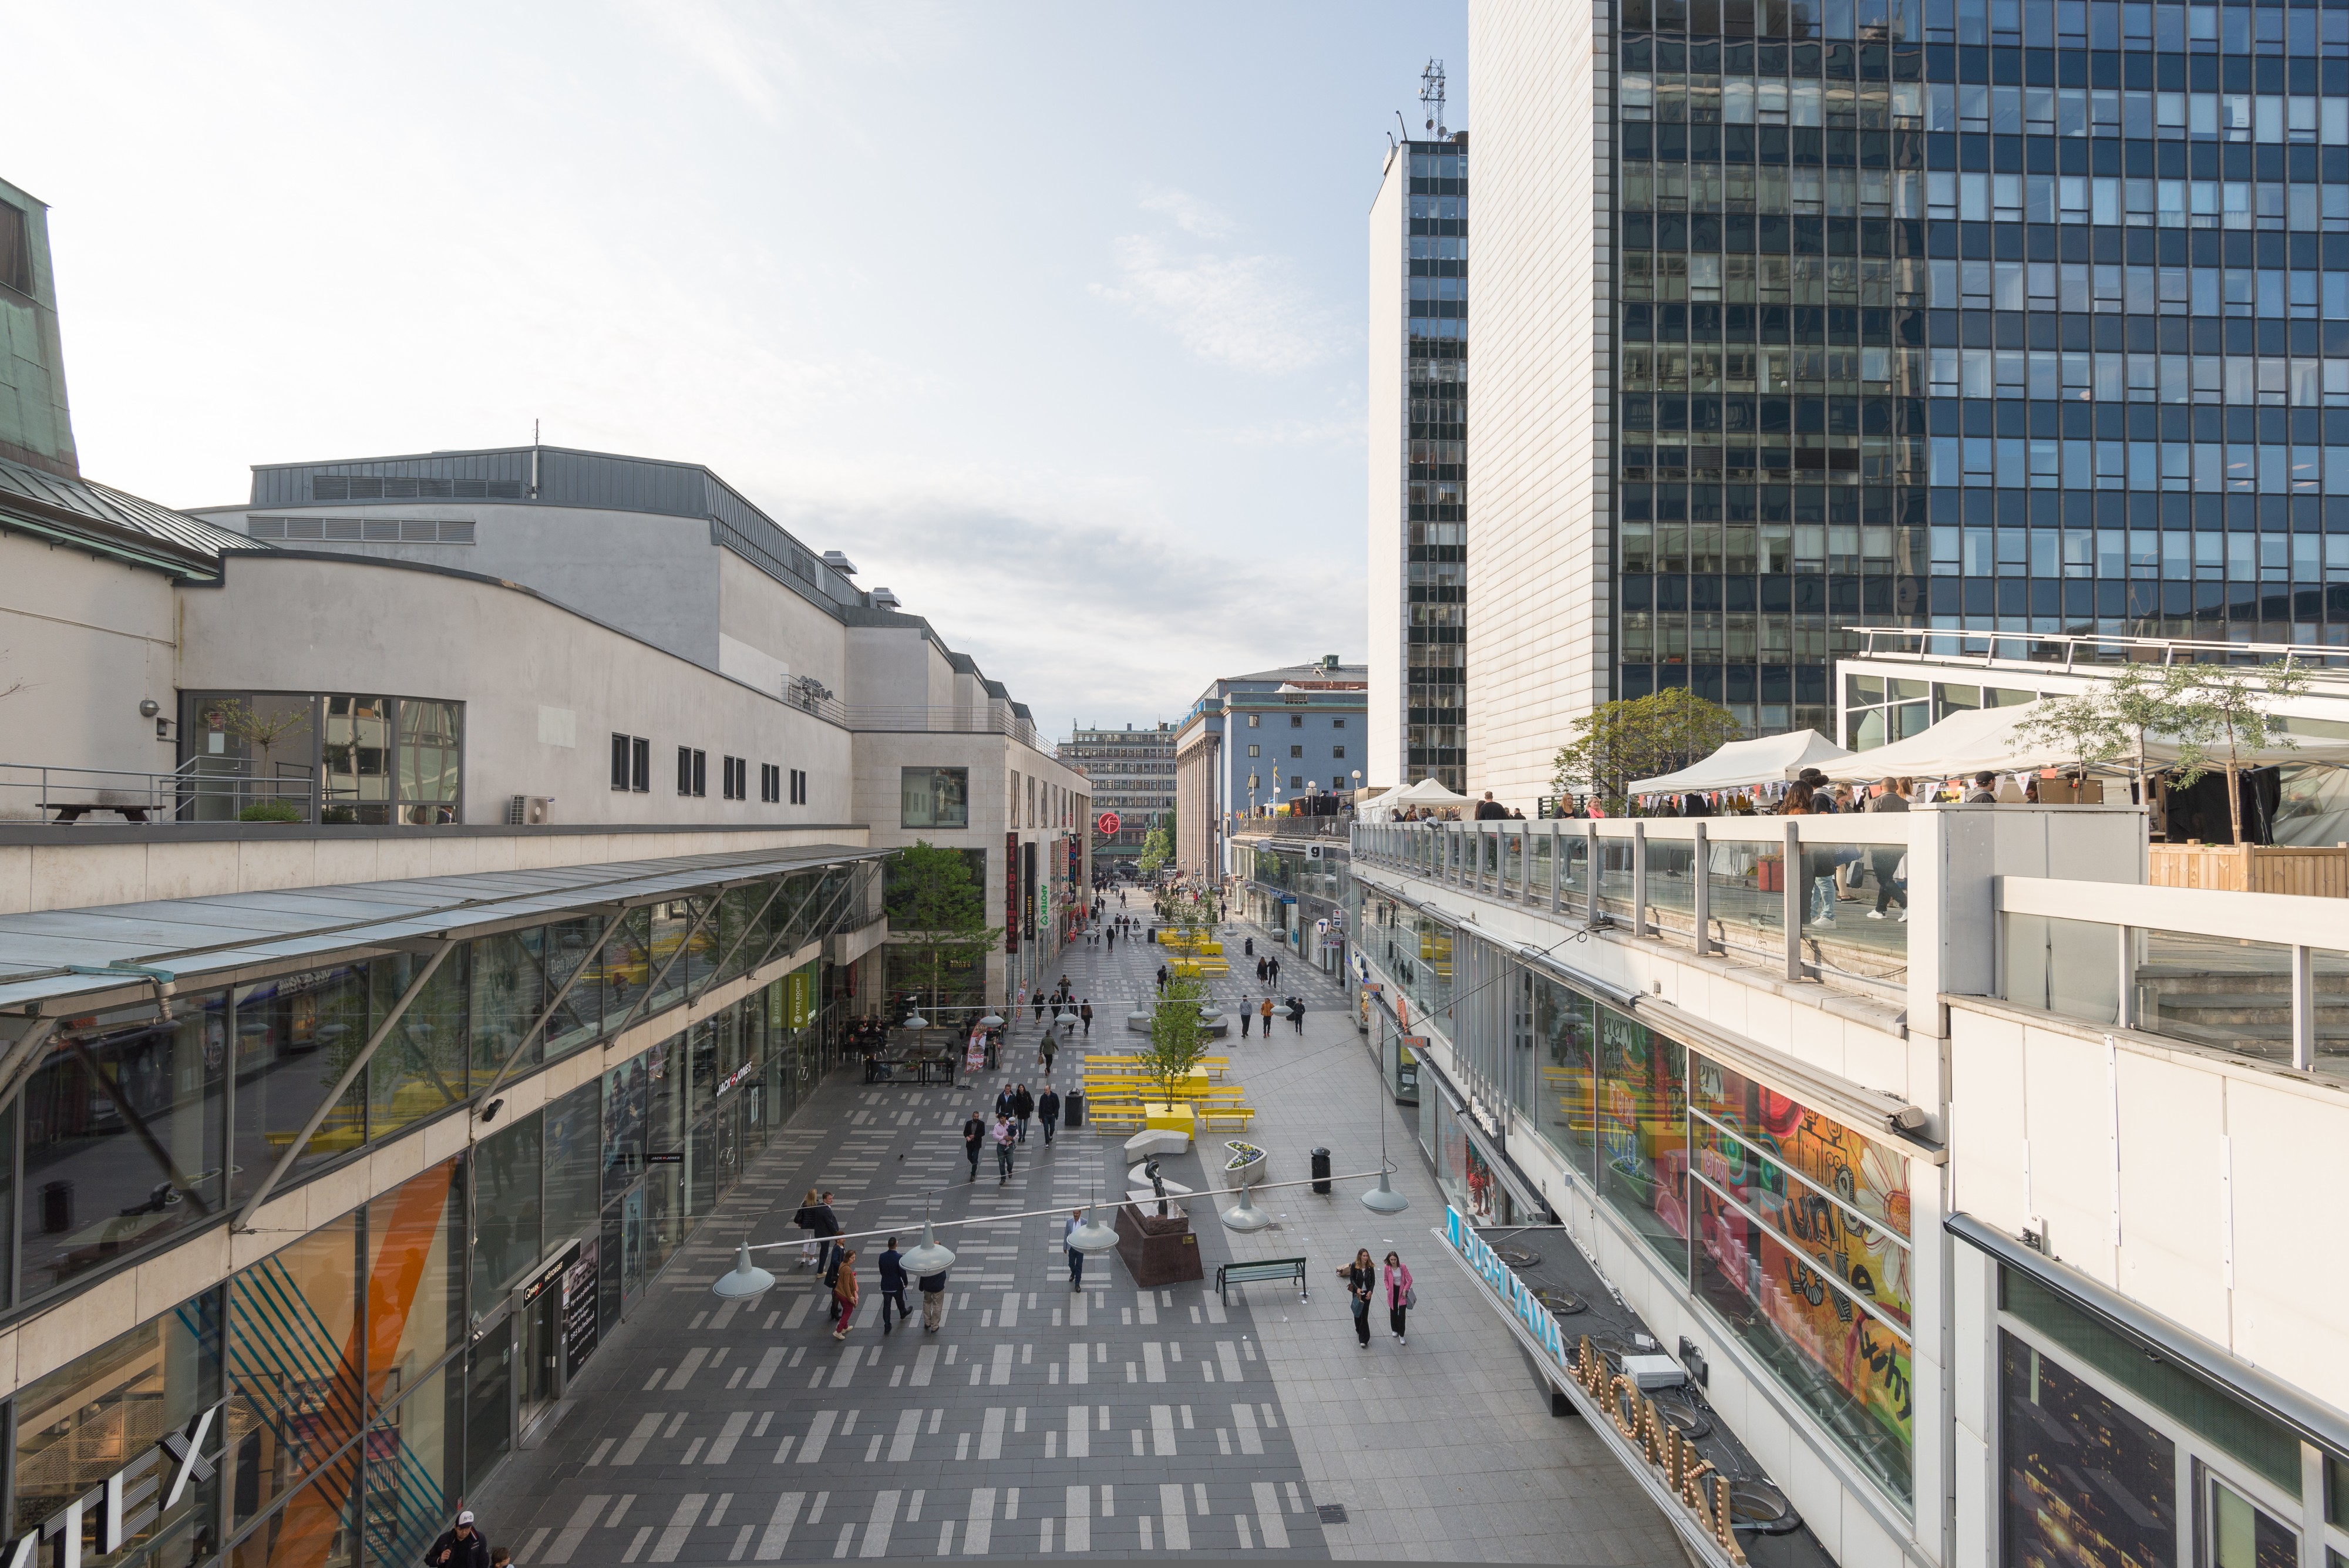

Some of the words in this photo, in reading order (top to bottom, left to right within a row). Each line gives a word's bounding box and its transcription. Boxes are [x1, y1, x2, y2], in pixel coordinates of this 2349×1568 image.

[1311, 846, 1320, 857] g
[1007, 873, 1016, 931] Bellman
[1318, 922, 1325, 932] T
[551, 959, 564, 974] Den
[1404, 1037, 1423, 1047] MQ
[716, 1077, 731, 1097] JACK
[736, 1061, 752, 1082] JONES
[1609, 1082, 1634, 1126] FUN
[1608, 1117, 1632, 1165] LOVE
[544, 1261, 563, 1282] HÖTORGET
[1464, 1227, 1510, 1300] SUSHI
[1510, 1274, 1567, 1367] YAMA
